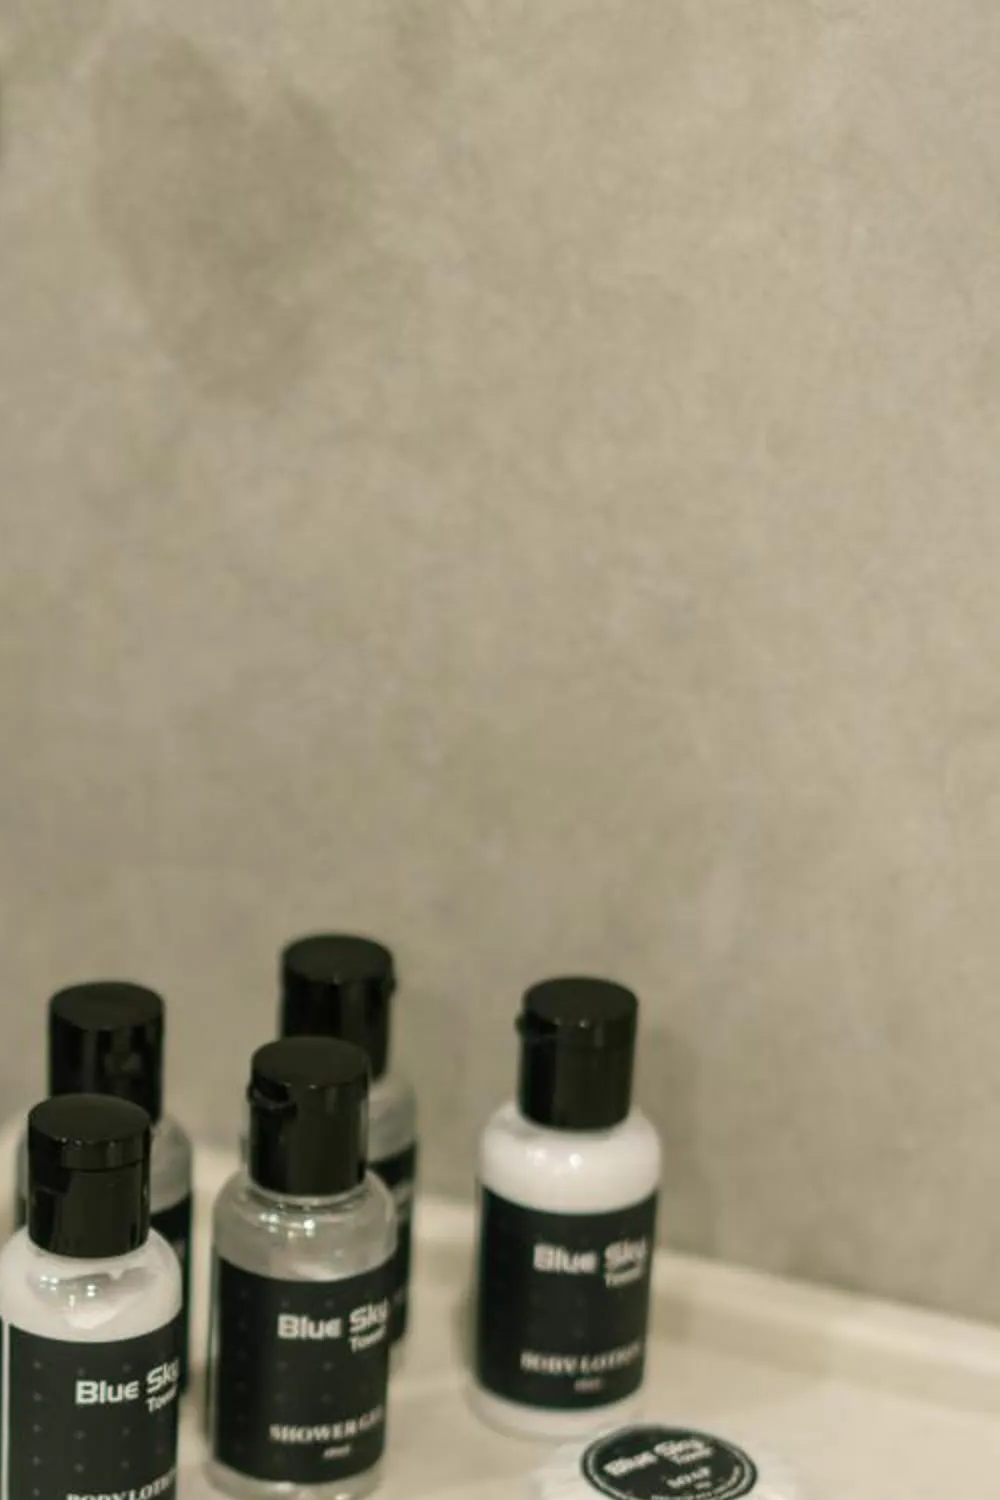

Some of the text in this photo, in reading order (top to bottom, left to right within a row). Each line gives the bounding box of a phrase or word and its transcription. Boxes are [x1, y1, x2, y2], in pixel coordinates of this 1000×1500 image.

[533, 1243, 598, 1274] Blue
[277, 1315, 343, 1340] Blue
[75, 1379, 139, 1405] Blue
[268, 1423, 357, 1445] SHOWER
